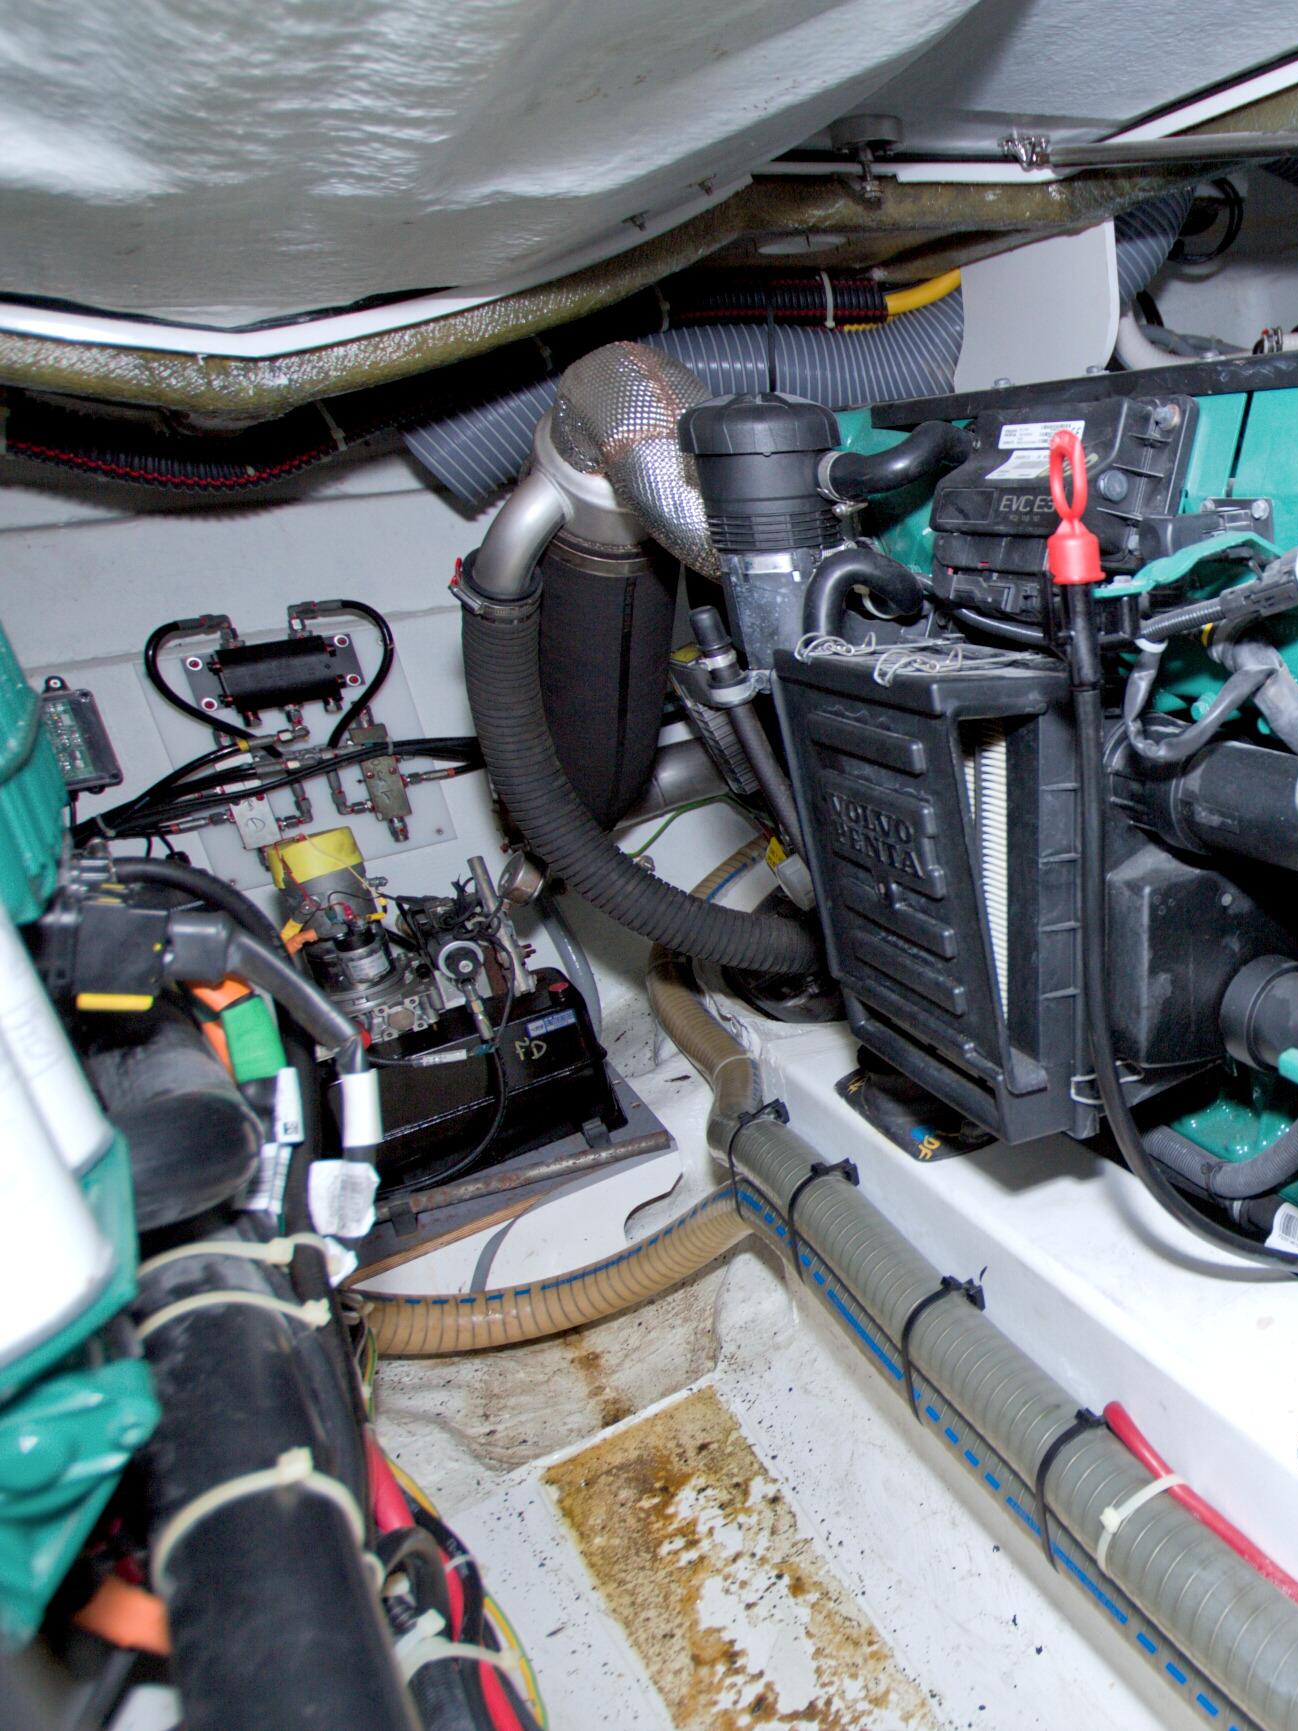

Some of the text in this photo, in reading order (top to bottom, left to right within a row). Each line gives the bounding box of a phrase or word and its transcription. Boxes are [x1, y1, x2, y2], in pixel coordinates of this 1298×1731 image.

[999, 495, 1034, 512] EVC
[826, 791, 915, 843] VOLVO
[836, 821, 926, 881] PENTA
